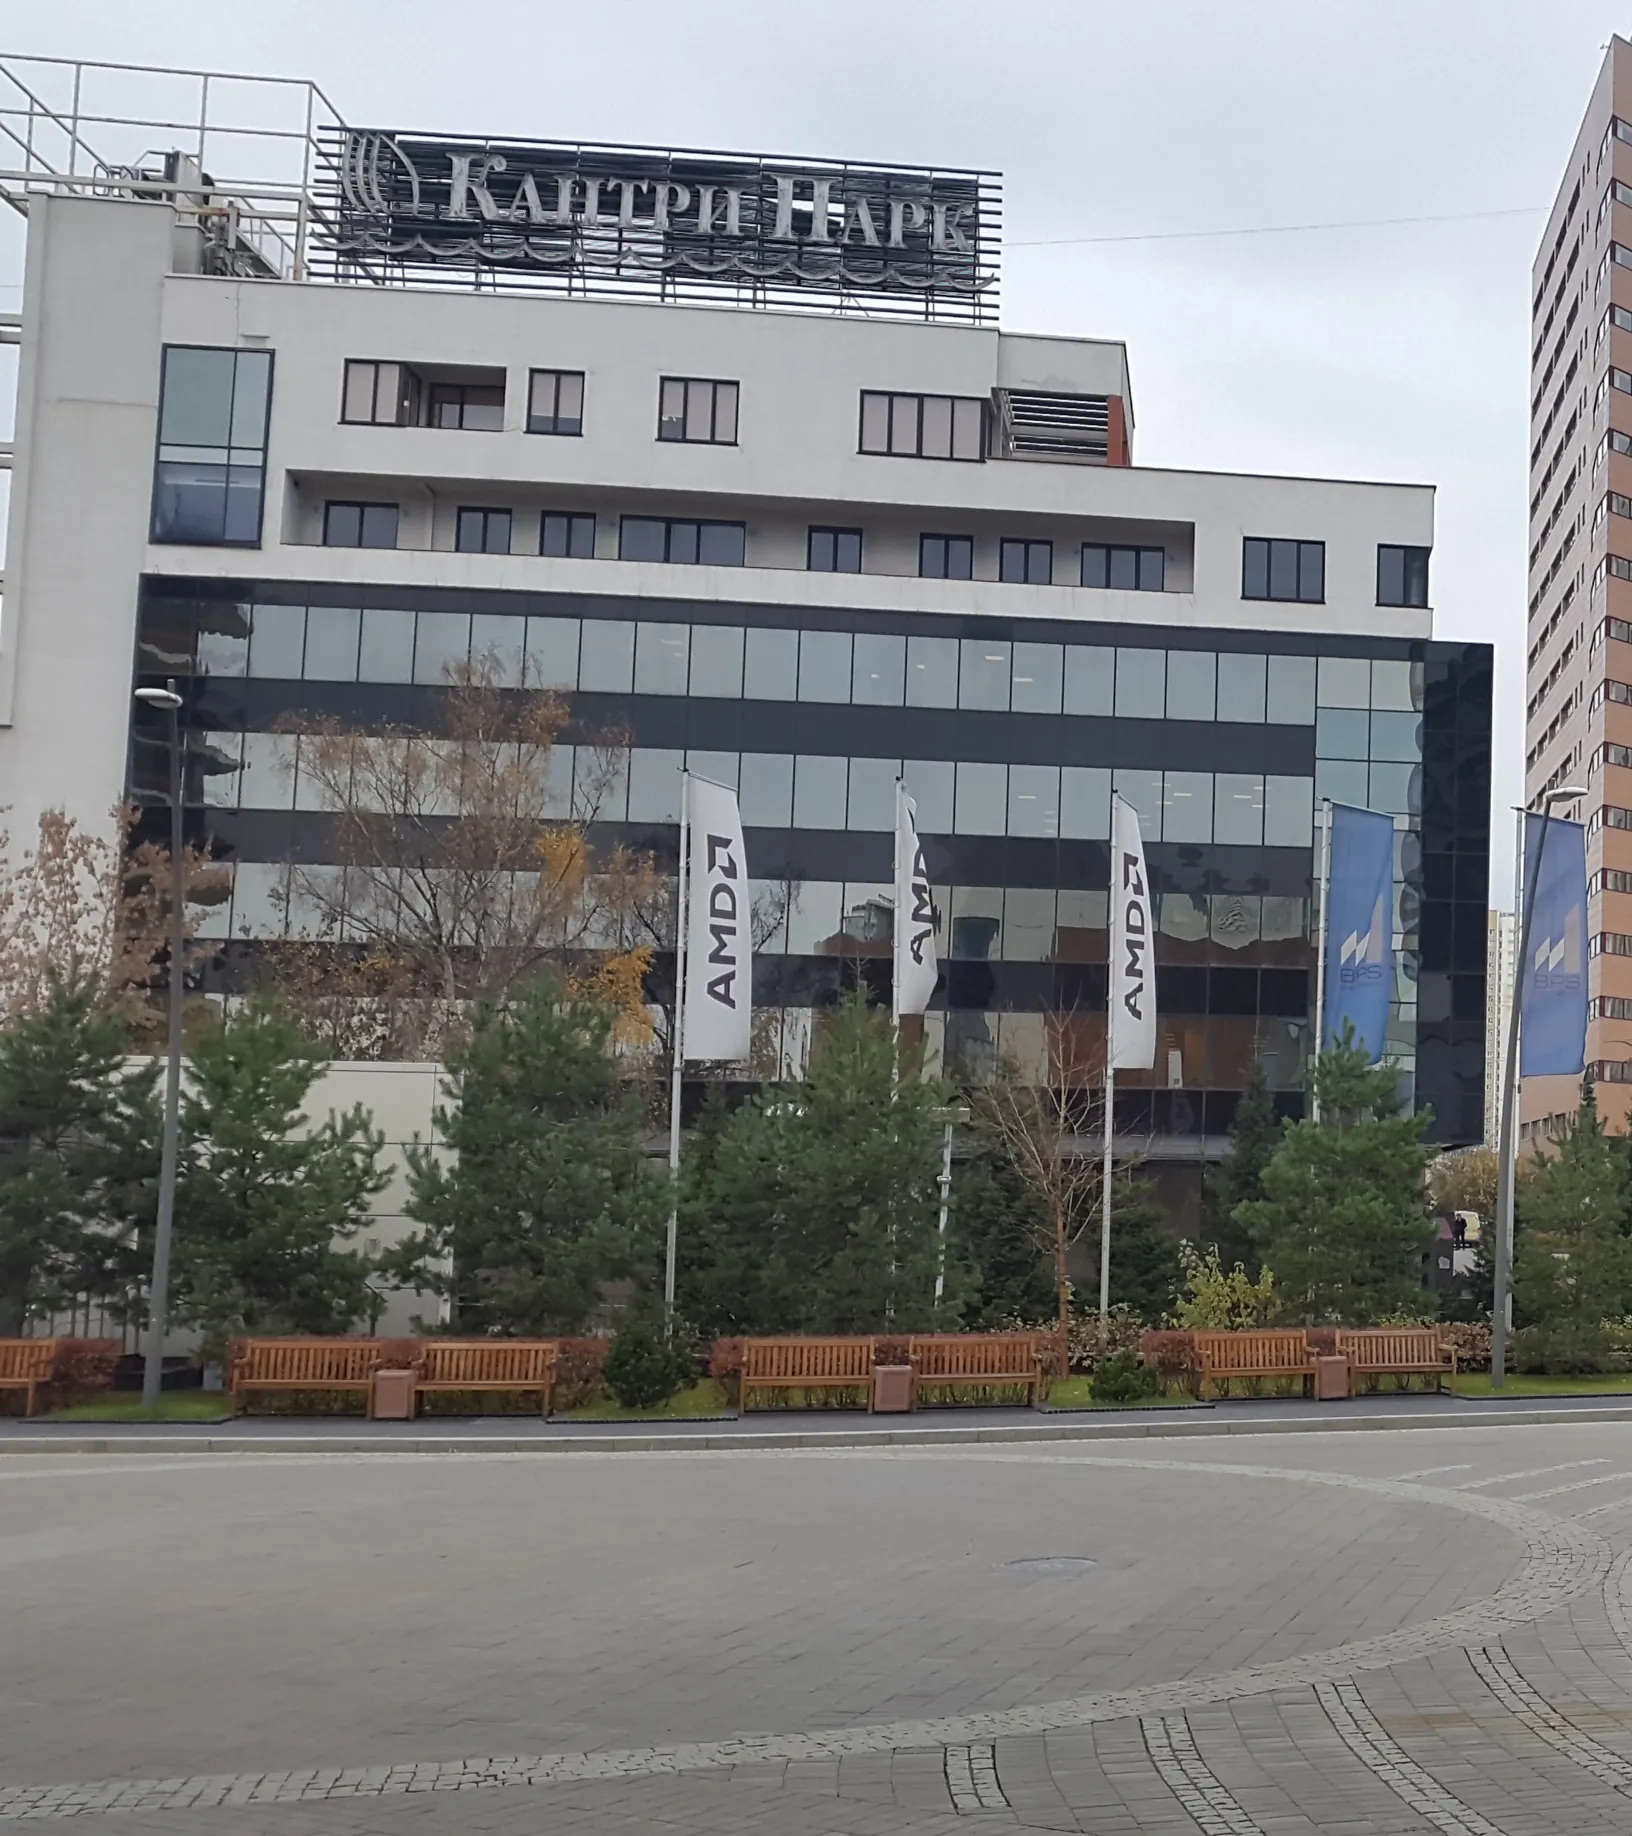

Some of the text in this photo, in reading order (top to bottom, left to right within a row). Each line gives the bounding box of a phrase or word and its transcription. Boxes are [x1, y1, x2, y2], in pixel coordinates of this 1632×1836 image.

[706, 881, 738, 1009] AMD
[1123, 901, 1145, 1020] AMD
[1340, 965, 1382, 983] BPS
[1534, 973, 1580, 989] BPS
